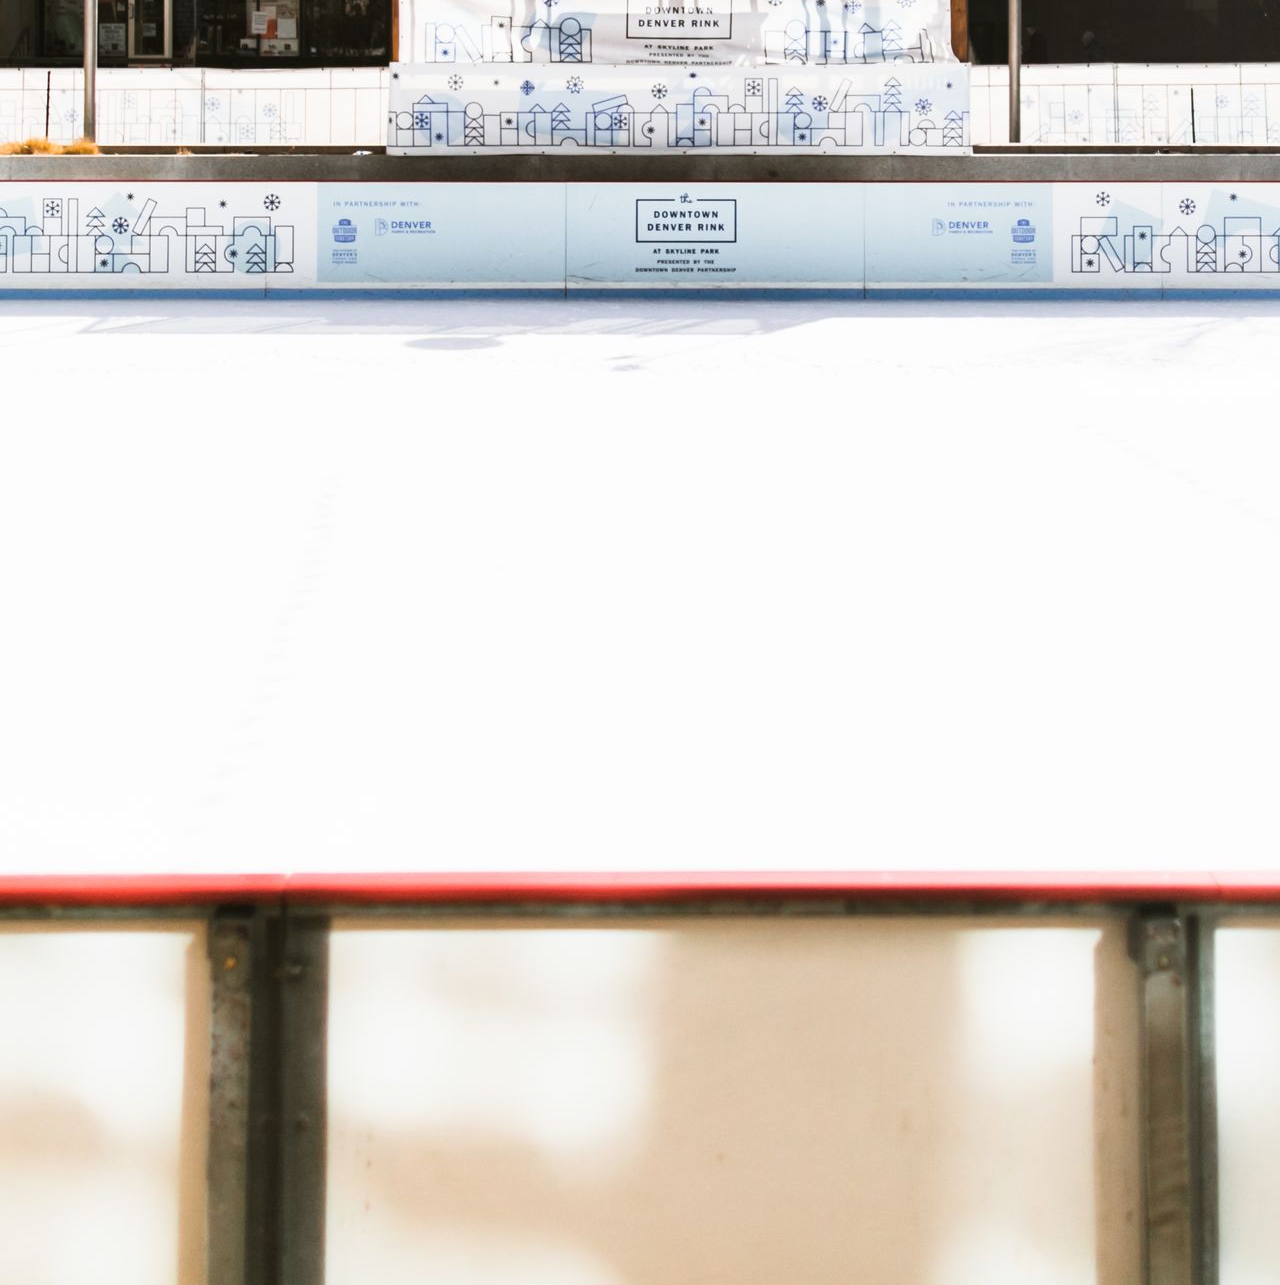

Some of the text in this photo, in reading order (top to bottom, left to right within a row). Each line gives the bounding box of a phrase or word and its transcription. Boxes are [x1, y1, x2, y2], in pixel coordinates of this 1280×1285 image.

[645, 6, 713, 15] DOWNTOWN
[638, 19, 720, 28] DENVER RINK
[679, 192, 693, 203] the
[653, 210, 719, 219] DOWNTOWN
[391, 221, 432, 229] DENVER
[647, 223, 725, 231] DENVER RINK
[948, 221, 989, 229] DENVER
